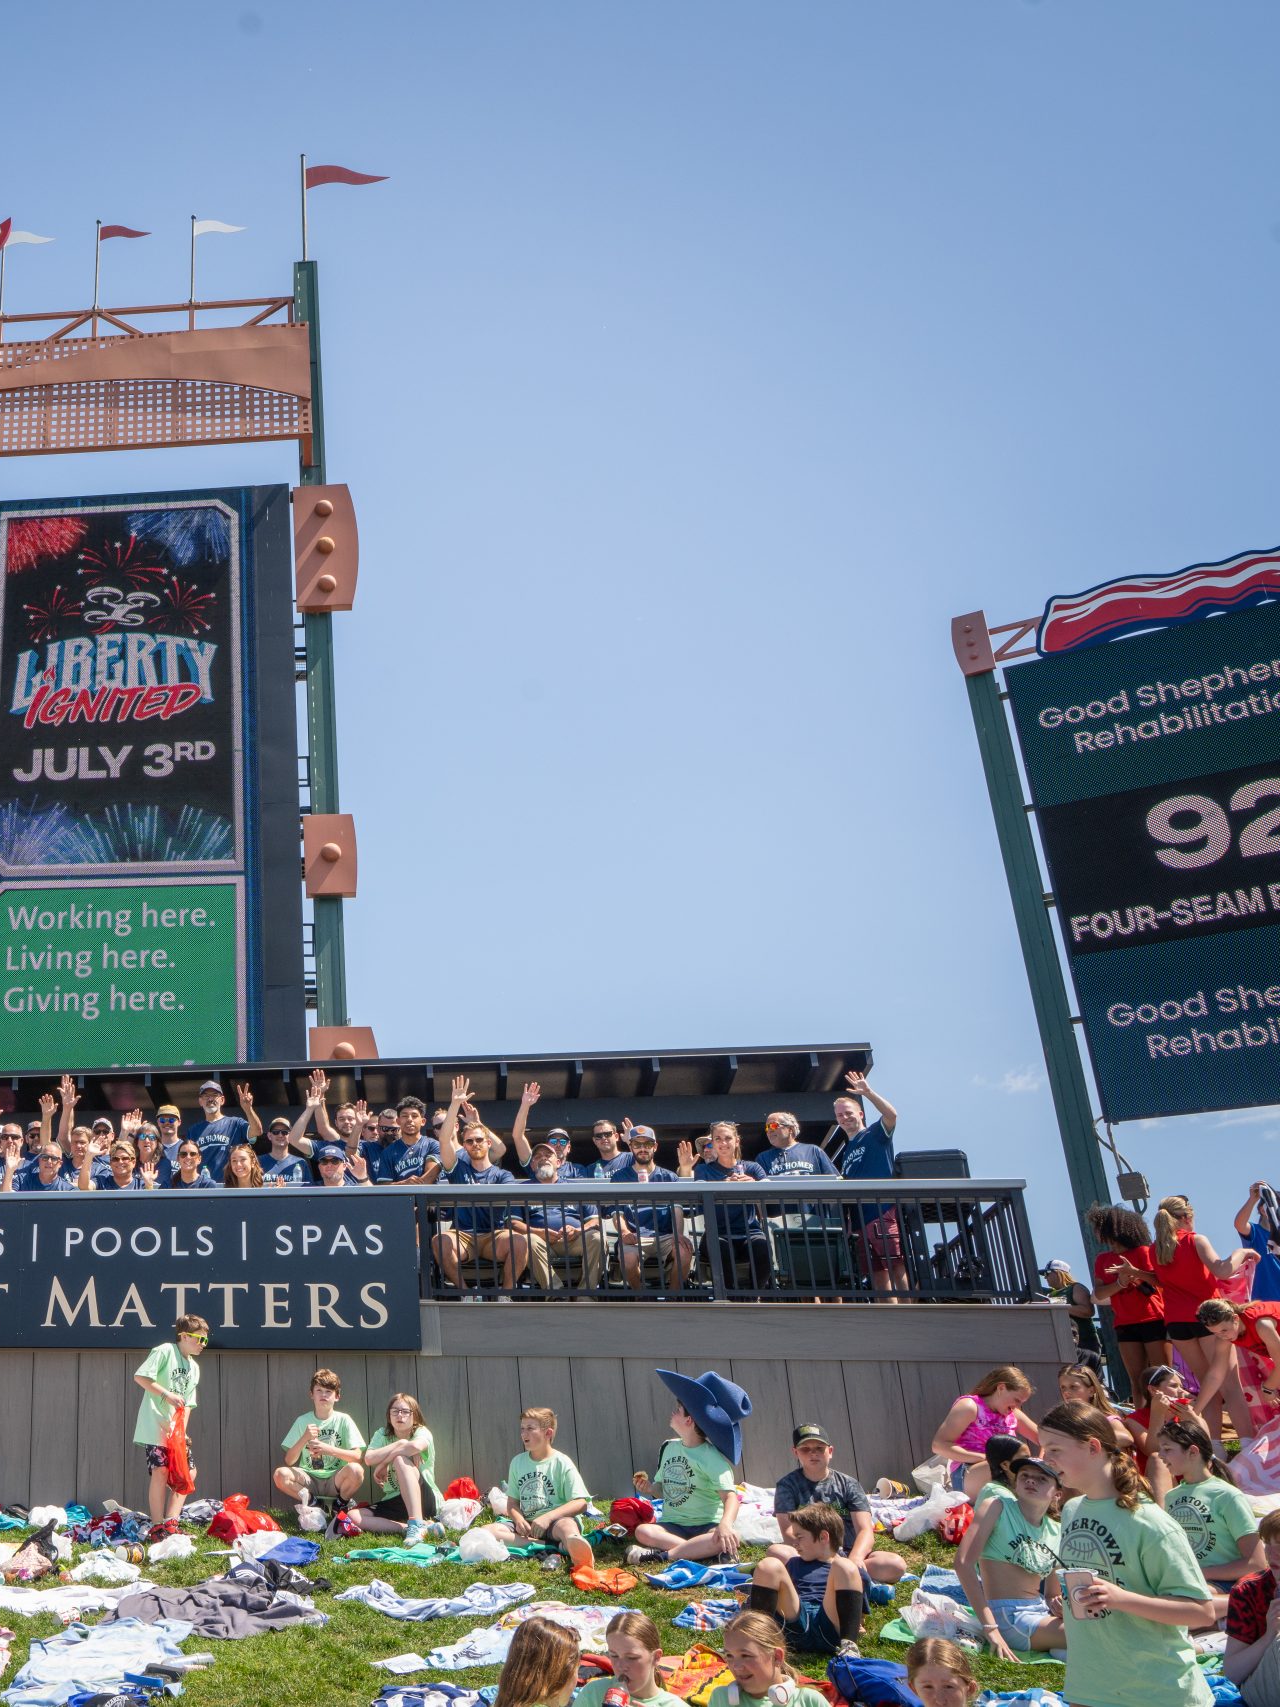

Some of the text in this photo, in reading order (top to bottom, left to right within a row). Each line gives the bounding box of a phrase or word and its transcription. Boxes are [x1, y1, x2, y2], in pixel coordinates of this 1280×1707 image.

[9, 632, 218, 715] LIBERTY
[23, 682, 203, 730] IGNITED
[1038, 690, 1131, 729] Good
[12, 740, 217, 782] JULY 3RD
[7, 901, 216, 937] Working here.
[1070, 885, 1267, 942] FOUR-SEAM
[5, 942, 176, 978] Living here.
[3, 983, 185, 1020] Giving here.
[1106, 990, 1209, 1028] Good
[785, 1160, 814, 1173] HOMES
[64, 1225, 216, 1257] POOLS
[274, 1223, 385, 1256] SPAS
